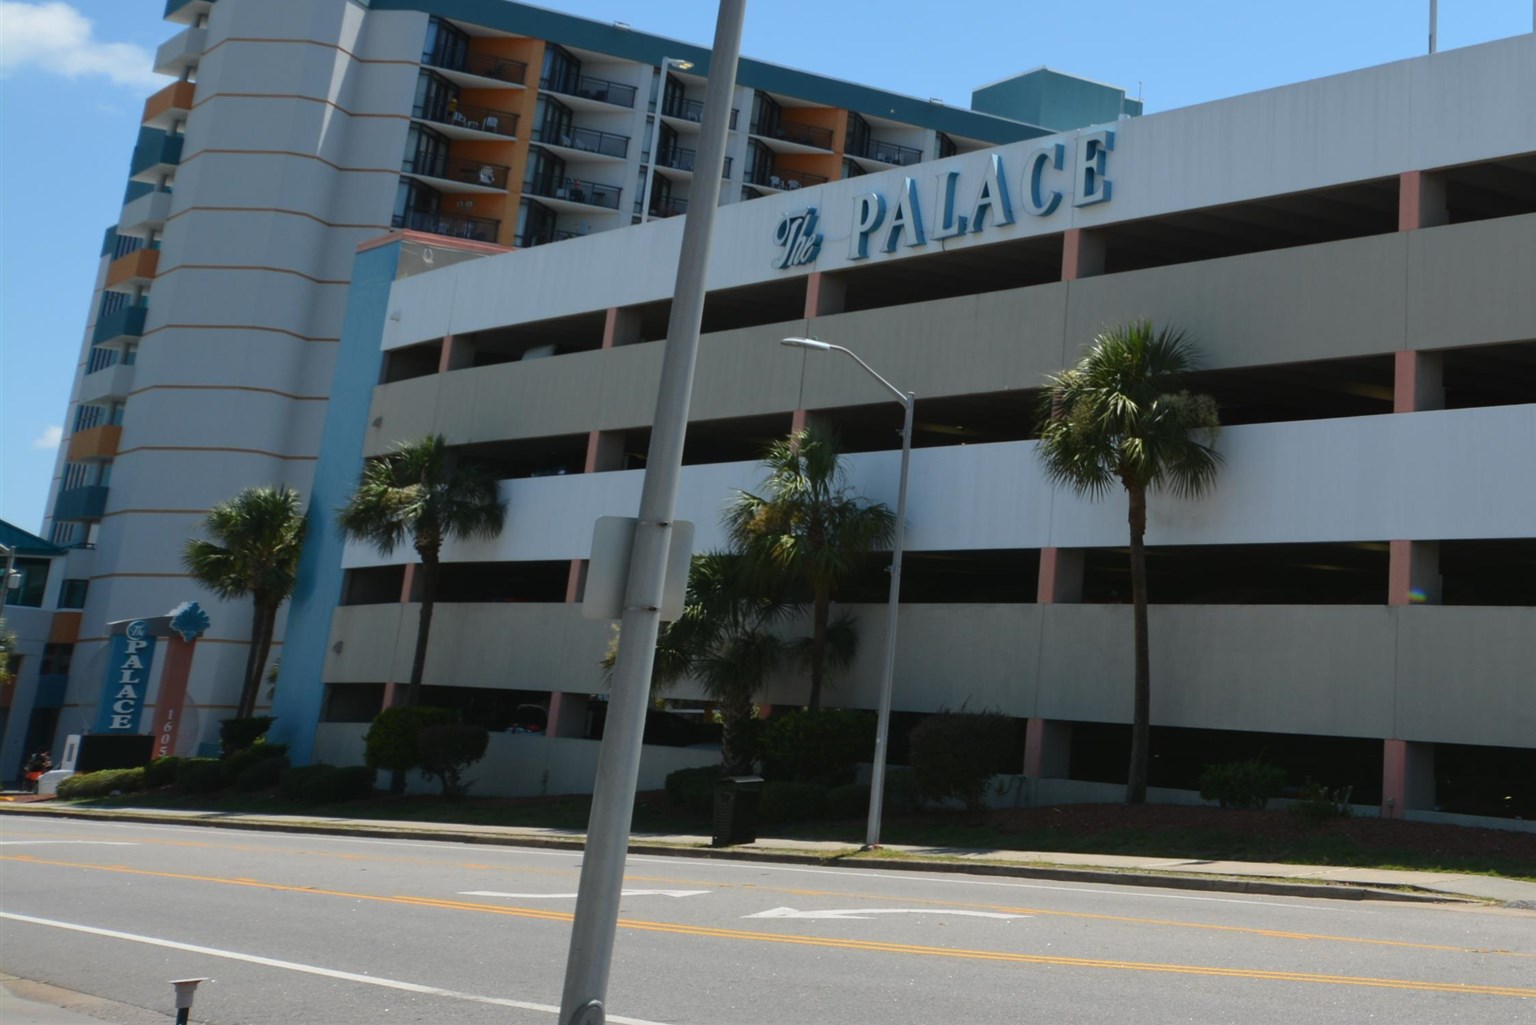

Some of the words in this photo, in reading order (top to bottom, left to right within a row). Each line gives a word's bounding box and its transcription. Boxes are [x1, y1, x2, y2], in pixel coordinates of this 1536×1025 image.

[771, 206, 824, 270] The
[846, 129, 1115, 261] PALACE
[109, 640, 147, 729] PALACE
[159, 709, 173, 756] 1605
